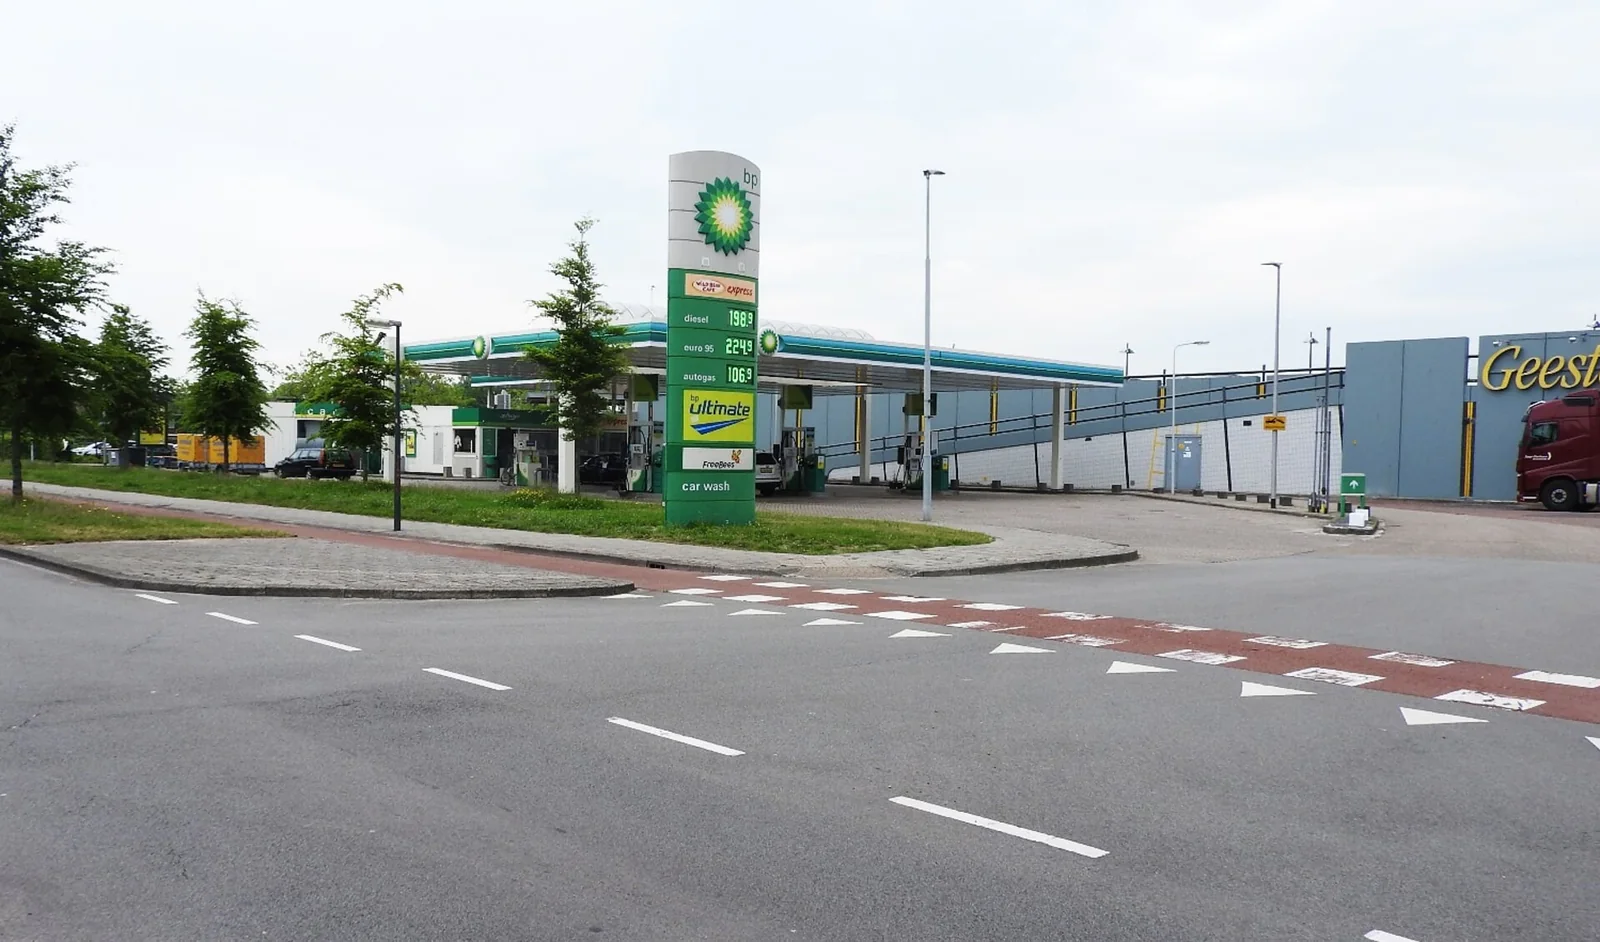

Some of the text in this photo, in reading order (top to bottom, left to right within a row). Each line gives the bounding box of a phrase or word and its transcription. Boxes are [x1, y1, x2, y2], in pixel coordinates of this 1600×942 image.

[743, 168, 758, 189] bp
[727, 285, 753, 297] express
[684, 313, 709, 324] diesel
[728, 309, 754, 328] 198.9
[683, 344, 715, 353] euro 95
[1481, 345, 1600, 391] Geest
[683, 373, 716, 382] autogas
[728, 366, 752, 384] 106.9
[690, 394, 699, 404] bp
[689, 400, 750, 417] ultimate
[702, 461, 735, 469] FreeBees
[682, 480, 730, 491] car wash
